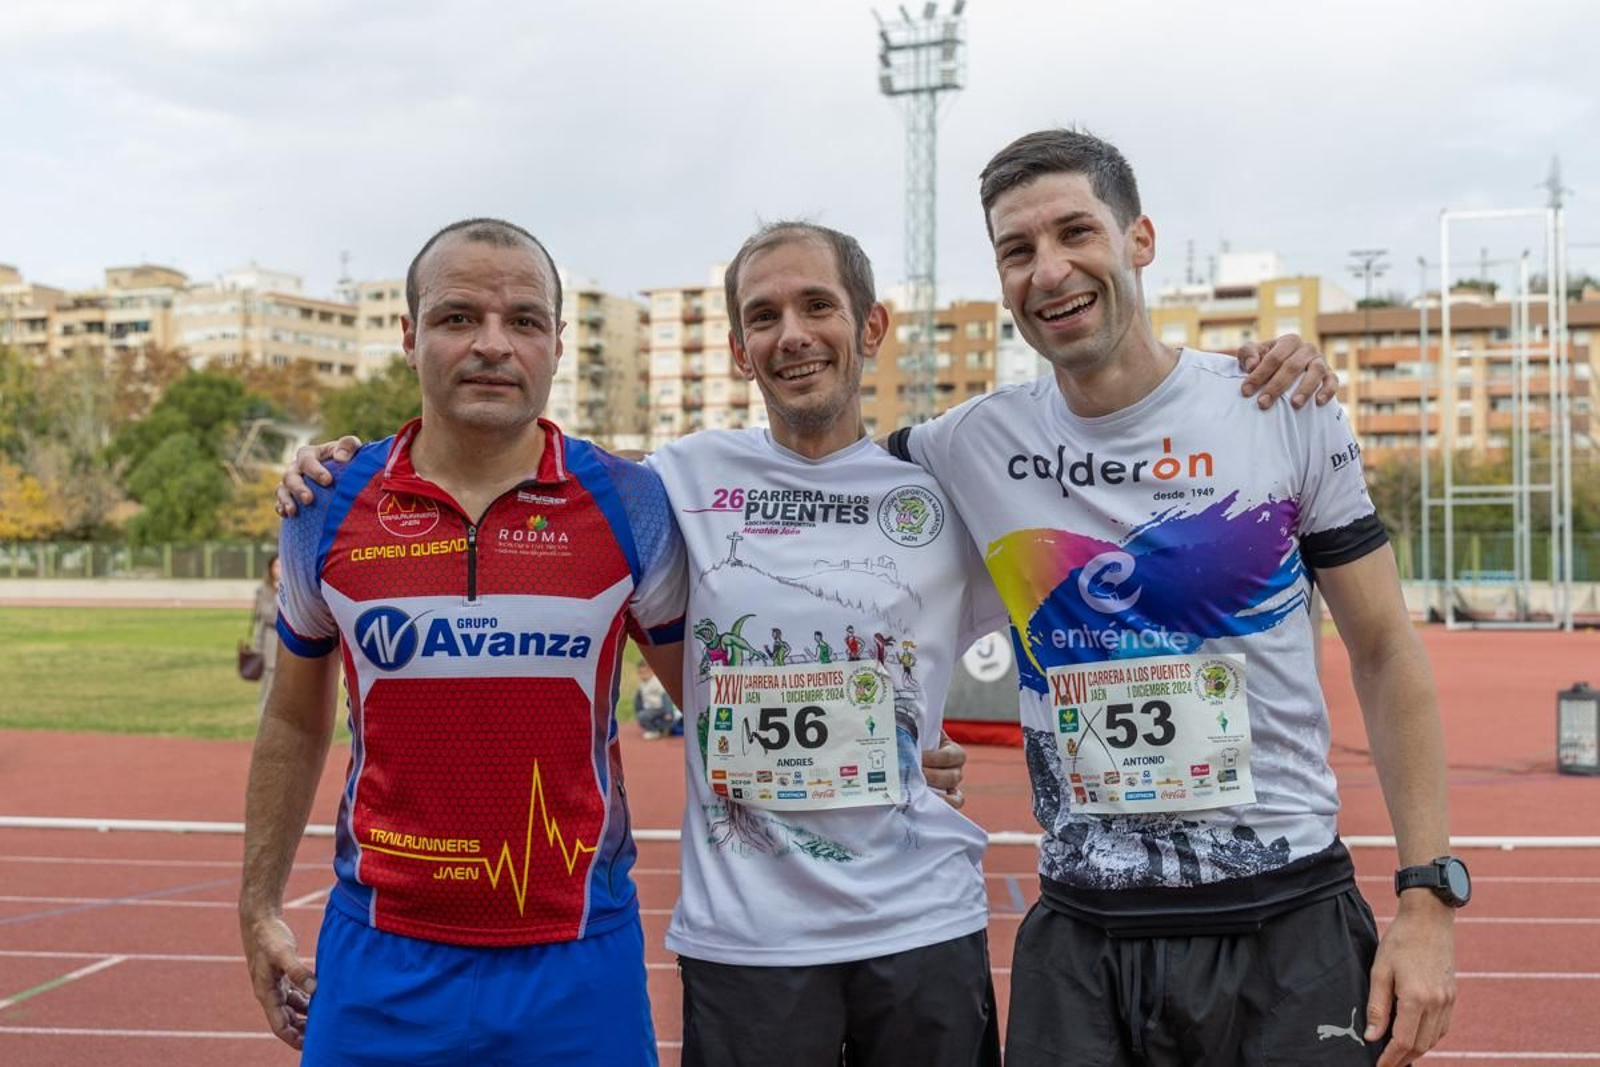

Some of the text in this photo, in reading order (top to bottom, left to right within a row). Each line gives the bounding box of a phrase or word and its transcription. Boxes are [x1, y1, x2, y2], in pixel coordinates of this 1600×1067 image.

[1008, 437, 1214, 498] calderón
[712, 488, 869, 509] 26 CARRERA DE LOS
[1153, 487, 1215, 501] desde 1949
[744, 501, 869, 525] PUENTES
[499, 529, 569, 543] RODMA
[351, 538, 468, 562] CLEMEN QUESAD
[457, 617, 498, 629] GRUPO
[421, 618, 591, 659] Avanza
[1051, 621, 1189, 652] entrénate
[744, 671, 844, 690] CARRERA A LOS PUENTES
[1087, 663, 1191, 686] CARRERA A LOS PUENTES
[714, 673, 744, 705] XXVI
[781, 691, 785, 703] 1
[786, 689, 825, 704] DICIEMBRE
[826, 687, 845, 701] 2024
[1050, 672, 1088, 706] XXVI
[1127, 685, 1130, 698] 1
[1132, 682, 1171, 698] DICIEMBRE
[1172, 681, 1192, 694] 2024
[759, 706, 828, 750] 56
[1106, 700, 1176, 749] 53
[777, 757, 814, 767] ANDRES
[1123, 755, 1164, 767] ANTONIO
[370, 828, 480, 853] TRAILRUNNERS
[433, 867, 480, 880] JAEN
